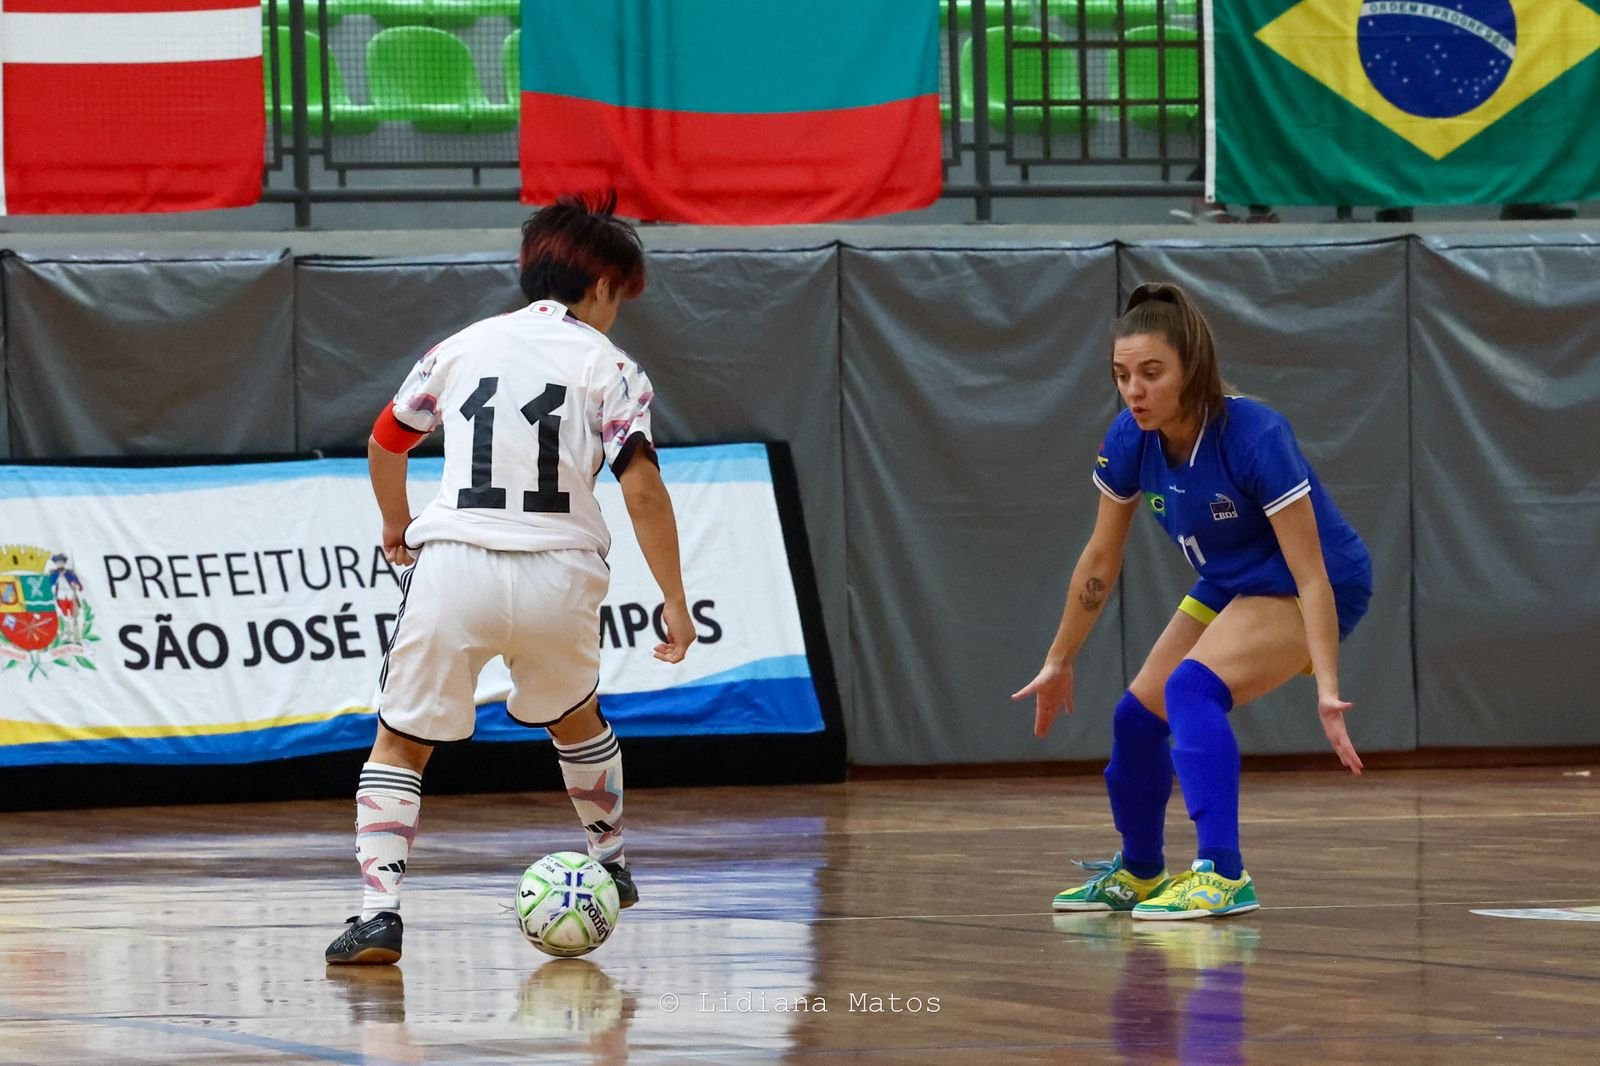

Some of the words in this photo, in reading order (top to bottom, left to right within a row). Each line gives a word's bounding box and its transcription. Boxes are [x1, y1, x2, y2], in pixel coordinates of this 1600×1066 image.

[1369, 2, 1418, 12] ORDEM
[1421, 5, 1429, 14] E
[1432, 7, 1510, 50] PROGRESSO
[457, 376, 571, 514] 11
[1213, 510, 1239, 521] CBDS
[103, 545, 400, 599] PREFEITURA
[118, 613, 230, 671] SÃO
[243, 602, 366, 668] JOSÉ
